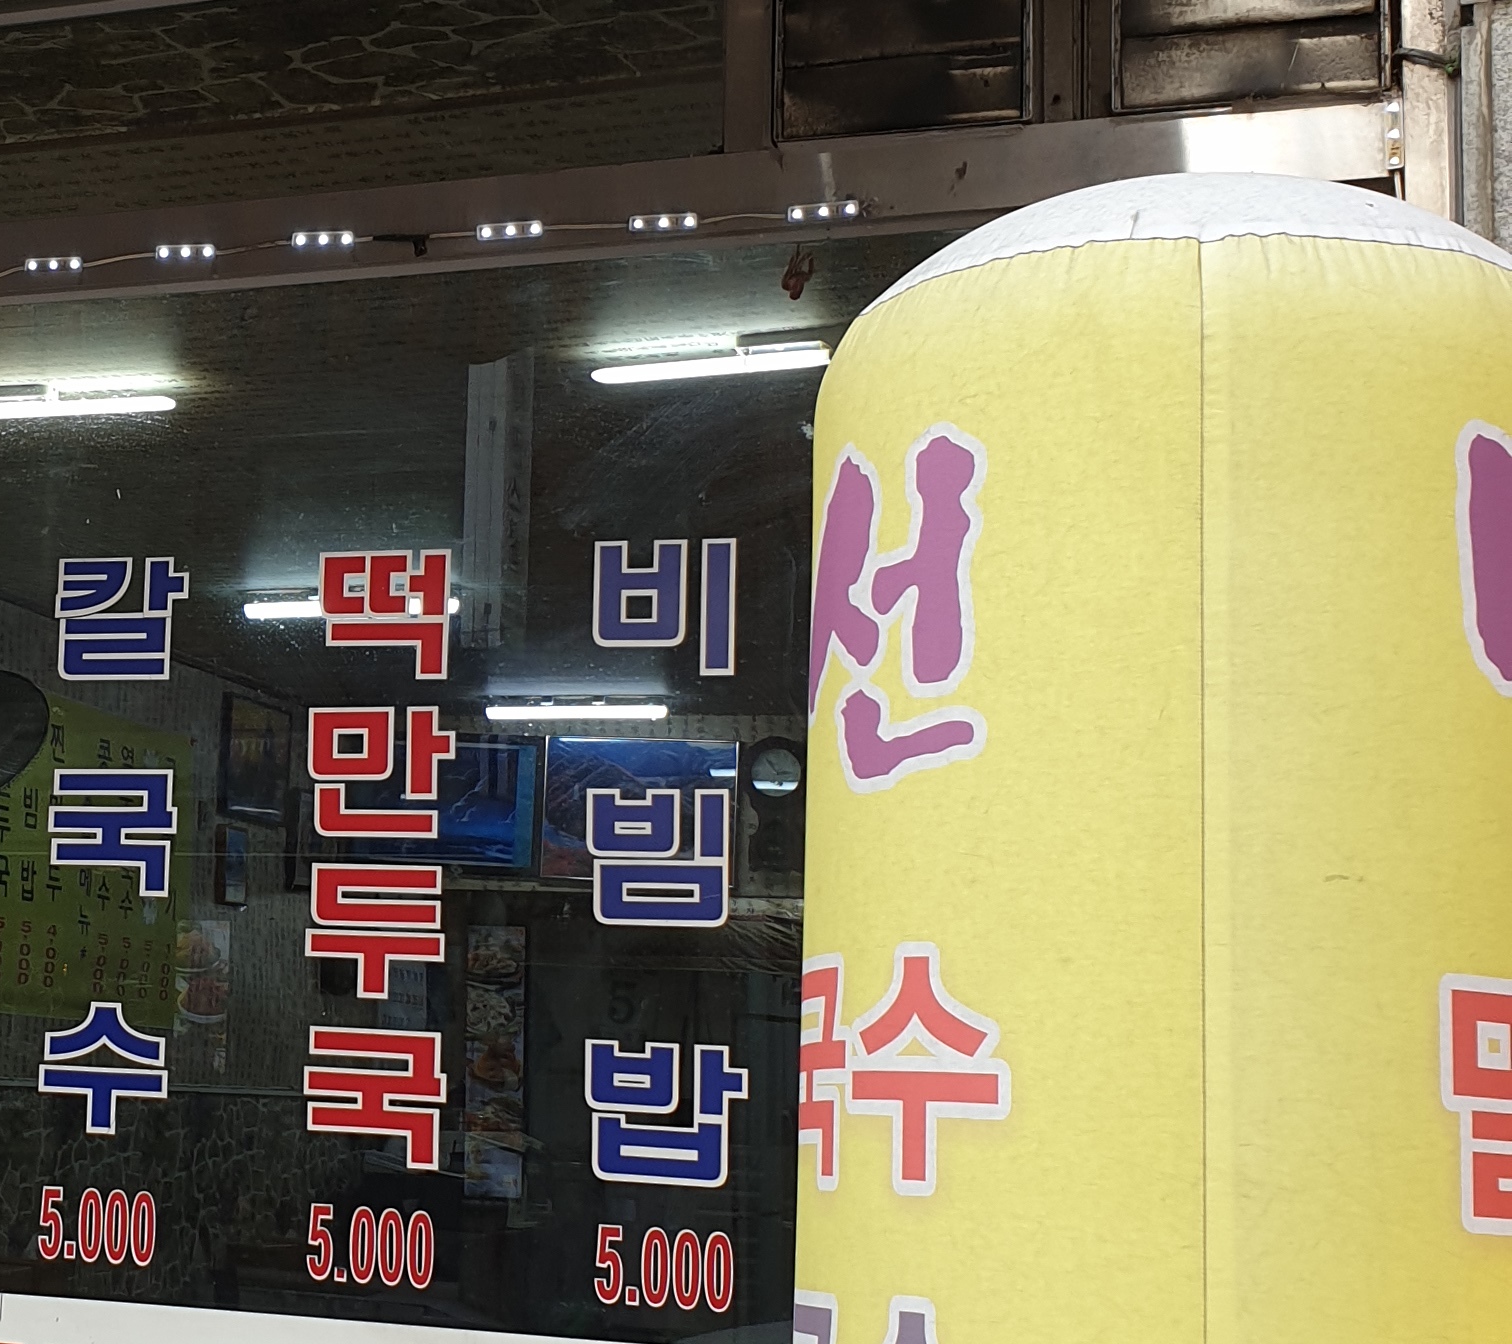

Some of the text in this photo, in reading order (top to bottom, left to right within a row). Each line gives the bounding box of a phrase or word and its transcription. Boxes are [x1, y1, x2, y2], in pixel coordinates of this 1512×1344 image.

[37, 556, 190, 1136] 칼국수
[302, 548, 457, 1171] 떡만두국
[583, 537, 750, 1188] 비빔밥
[37, 1185, 157, 1267] 5.000
[305, 1202, 436, 1291] 5.000
[594, 1223, 735, 1314] 5.000
